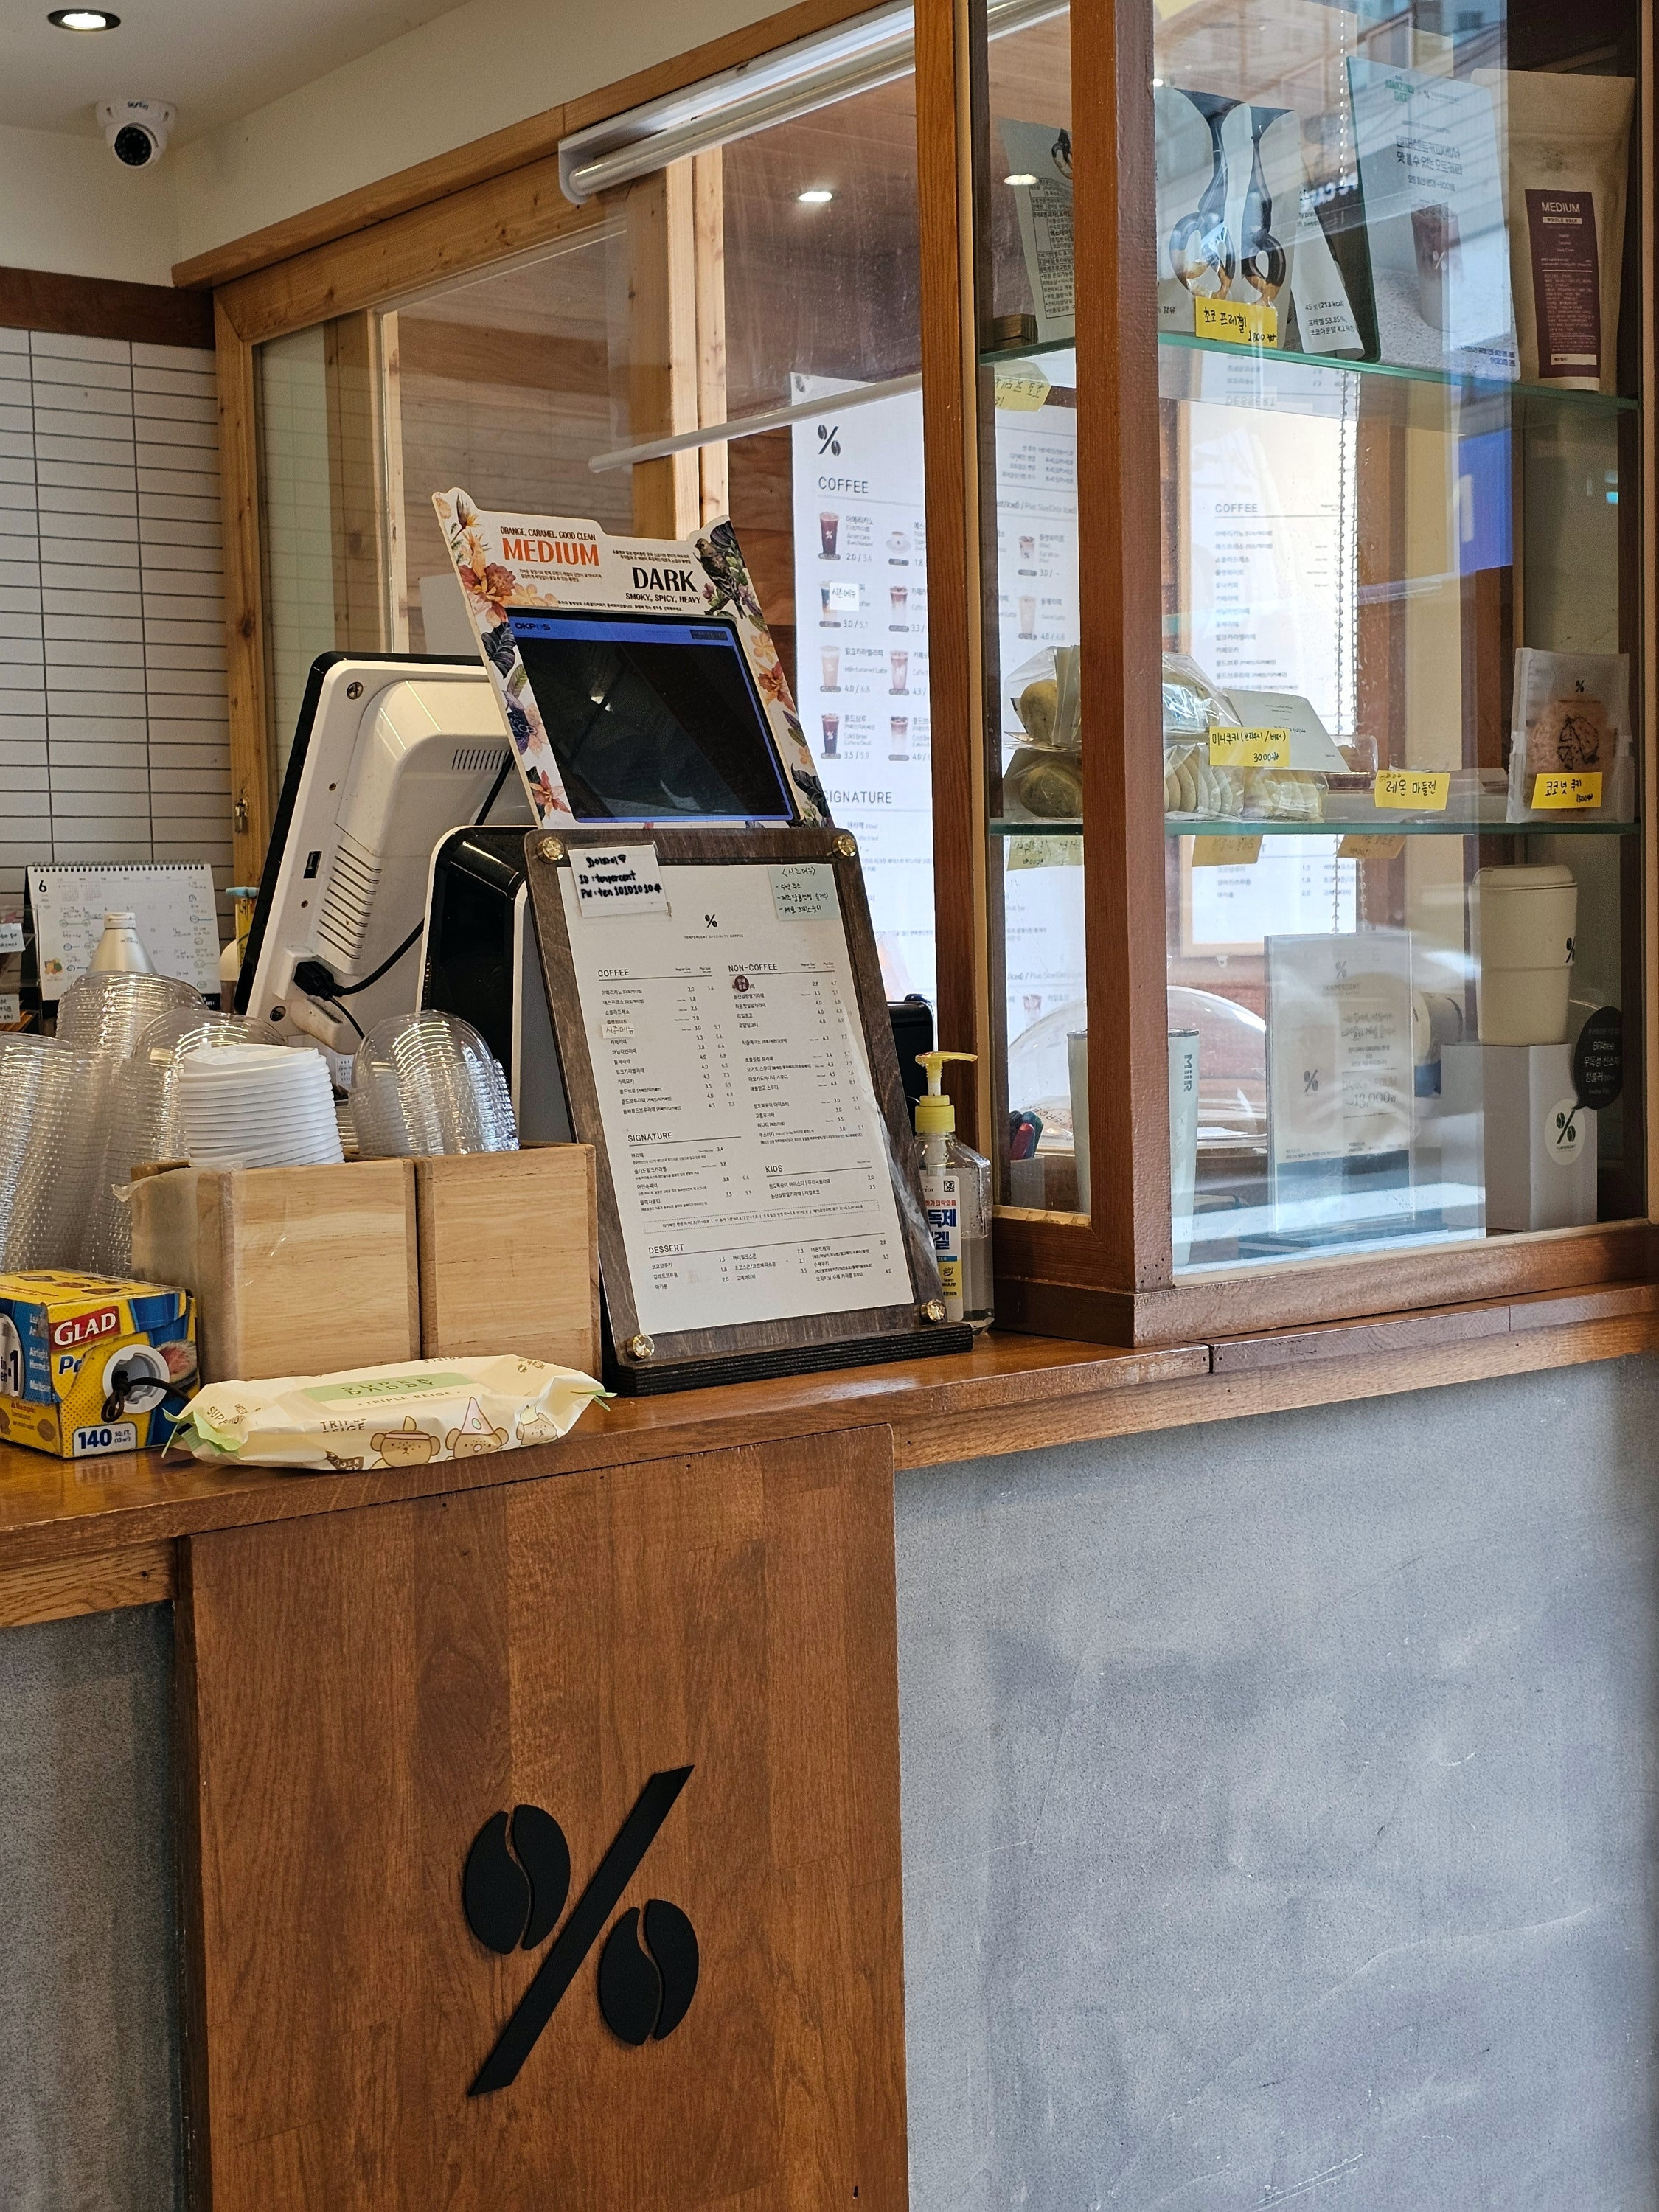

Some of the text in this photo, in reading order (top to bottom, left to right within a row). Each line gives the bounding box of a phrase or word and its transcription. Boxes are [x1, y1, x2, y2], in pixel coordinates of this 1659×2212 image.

[1542, 202, 1580, 212] MEDIUM
[1164, 306, 1175, 314] 함유
[1203, 307, 1217, 323] 초코
[818, 476, 869, 494] COFFEE
[1215, 504, 1258, 513] COFFEE
[500, 526, 596, 540] ORANGE, CARAMEL, GOOD CLEAN
[502, 537, 599, 566] MEDIUM
[632, 566, 698, 592] DARK
[625, 593, 700, 604] SMOKY, SPICY, HEAVY
[1386, 779, 1436, 796] 레몬 마들렌
[1545, 780, 1567, 796] 코코넛
[826, 790, 892, 804] SIGNATURE
[38, 880, 47, 892] 6
[598, 969, 630, 977] COFFEE
[728, 963, 778, 972] NON-COFFEE
[606, 1026, 634, 1034] 시즌메뉴
[1584, 1057, 1601, 1067] 무독성
[627, 1132, 673, 1142] SIGNATURE
[765, 1164, 783, 1173] KIDS
[933, 1231, 950, 1250] 겔
[649, 1244, 684, 1254] DESSERT
[53, 1312, 117, 1346] GLAD
[341, 1377, 430, 1392] SUPER
[348, 1380, 435, 1396] DADDY
[414, 1391, 454, 1399] BEIGE
[78, 1428, 113, 1450] 140
